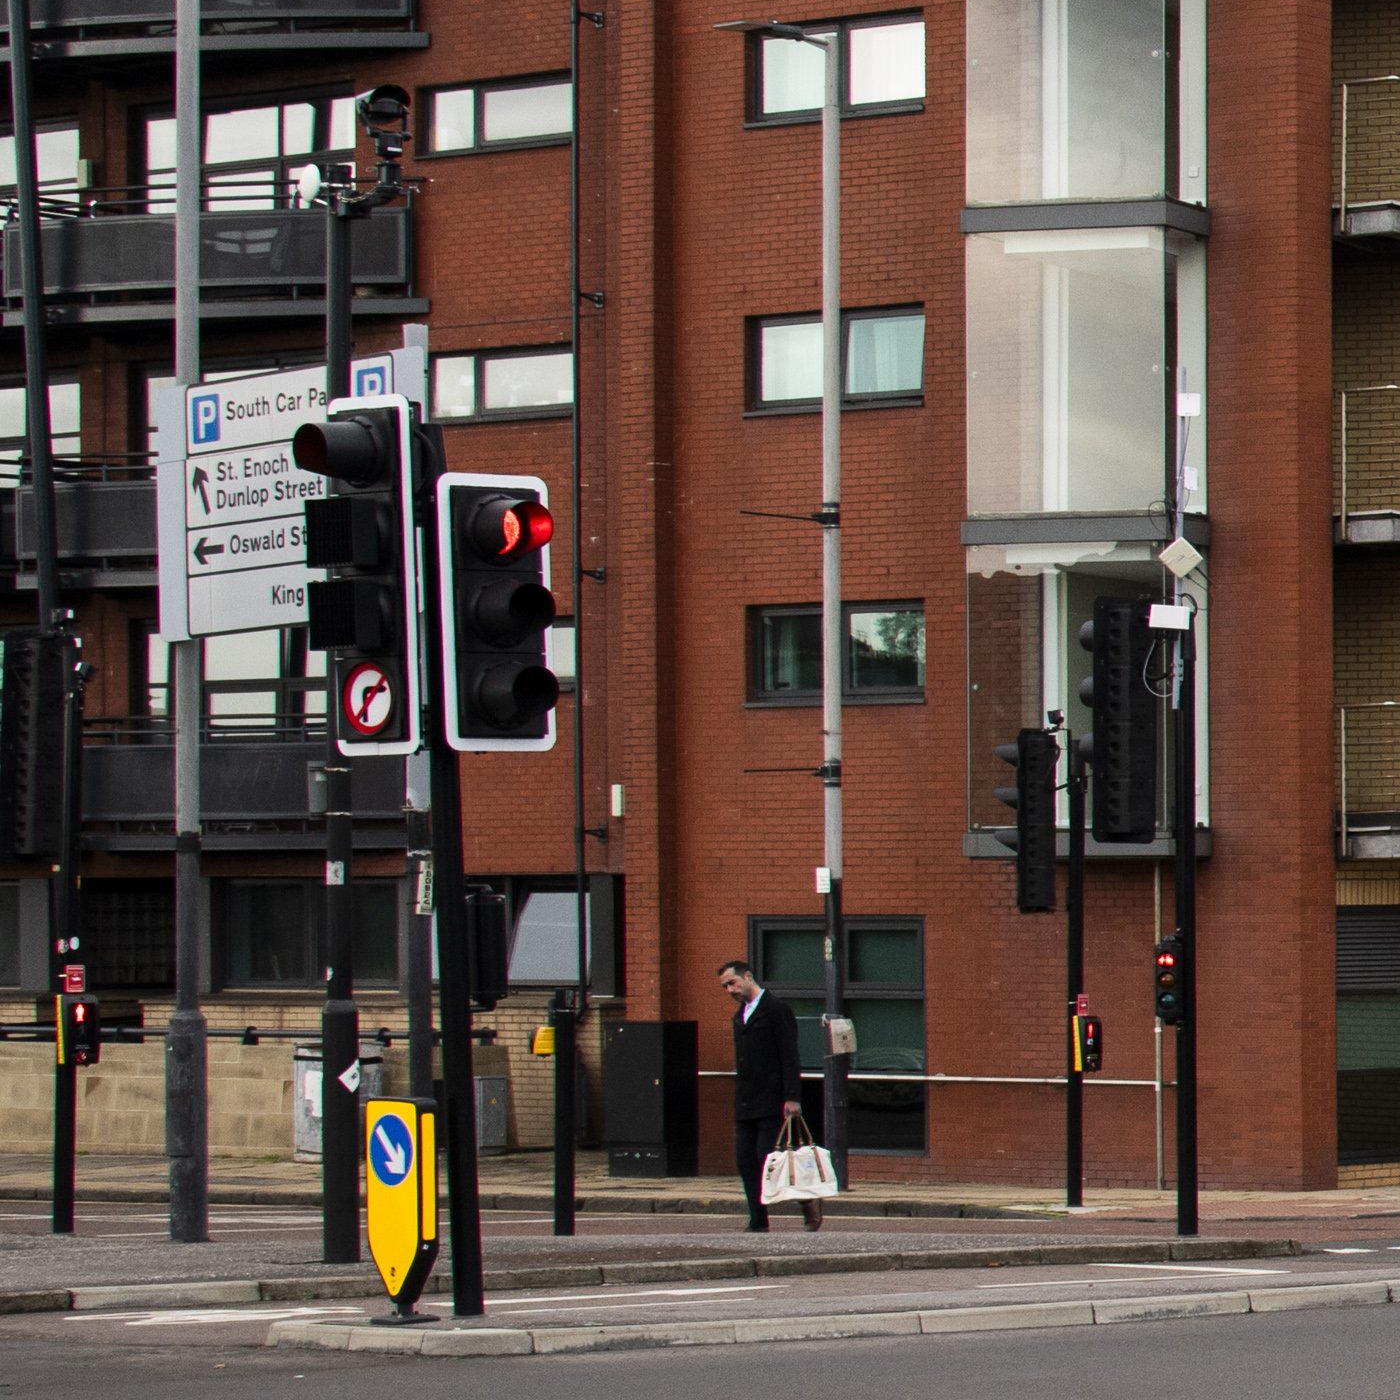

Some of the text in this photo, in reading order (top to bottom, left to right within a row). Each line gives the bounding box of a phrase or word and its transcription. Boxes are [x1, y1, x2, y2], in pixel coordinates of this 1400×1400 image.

[198, 400, 217, 440] P
[226, 396, 271, 421] South
[276, 392, 302, 413] Car
[308, 387, 328, 408] Pa
[216, 453, 289, 482] St. Enoch
[216, 476, 323, 510] Dunlop Street
[230, 526, 308, 555] Oswald St
[271, 584, 305, 607] King
